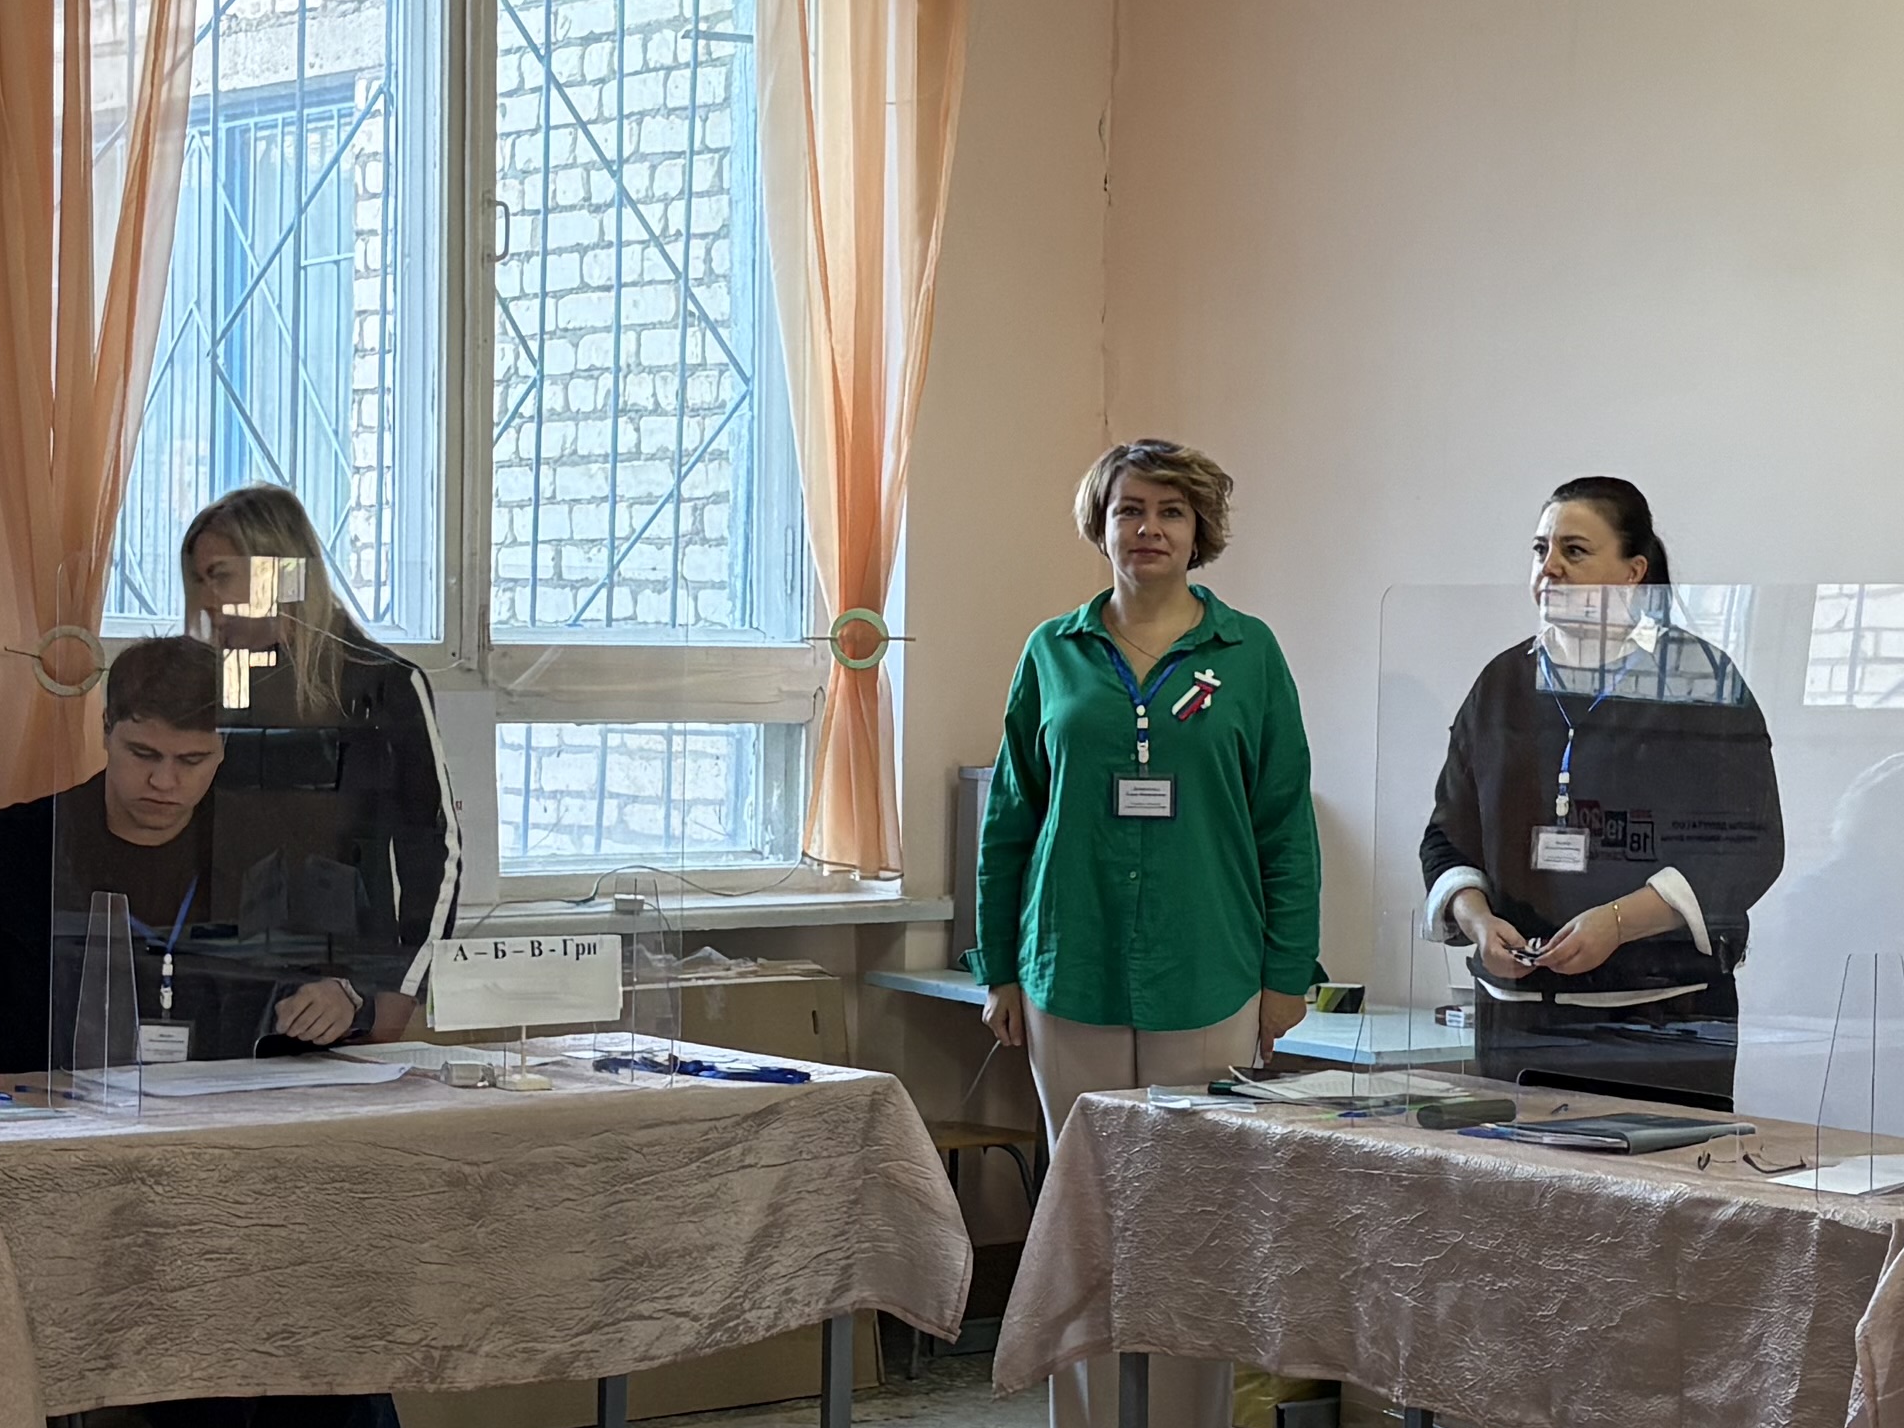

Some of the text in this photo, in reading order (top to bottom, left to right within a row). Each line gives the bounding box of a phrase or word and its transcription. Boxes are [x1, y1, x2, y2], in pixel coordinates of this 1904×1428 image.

[453, 943, 468, 962] А
[493, 941, 507, 960] Б
[530, 939, 543, 958] В
